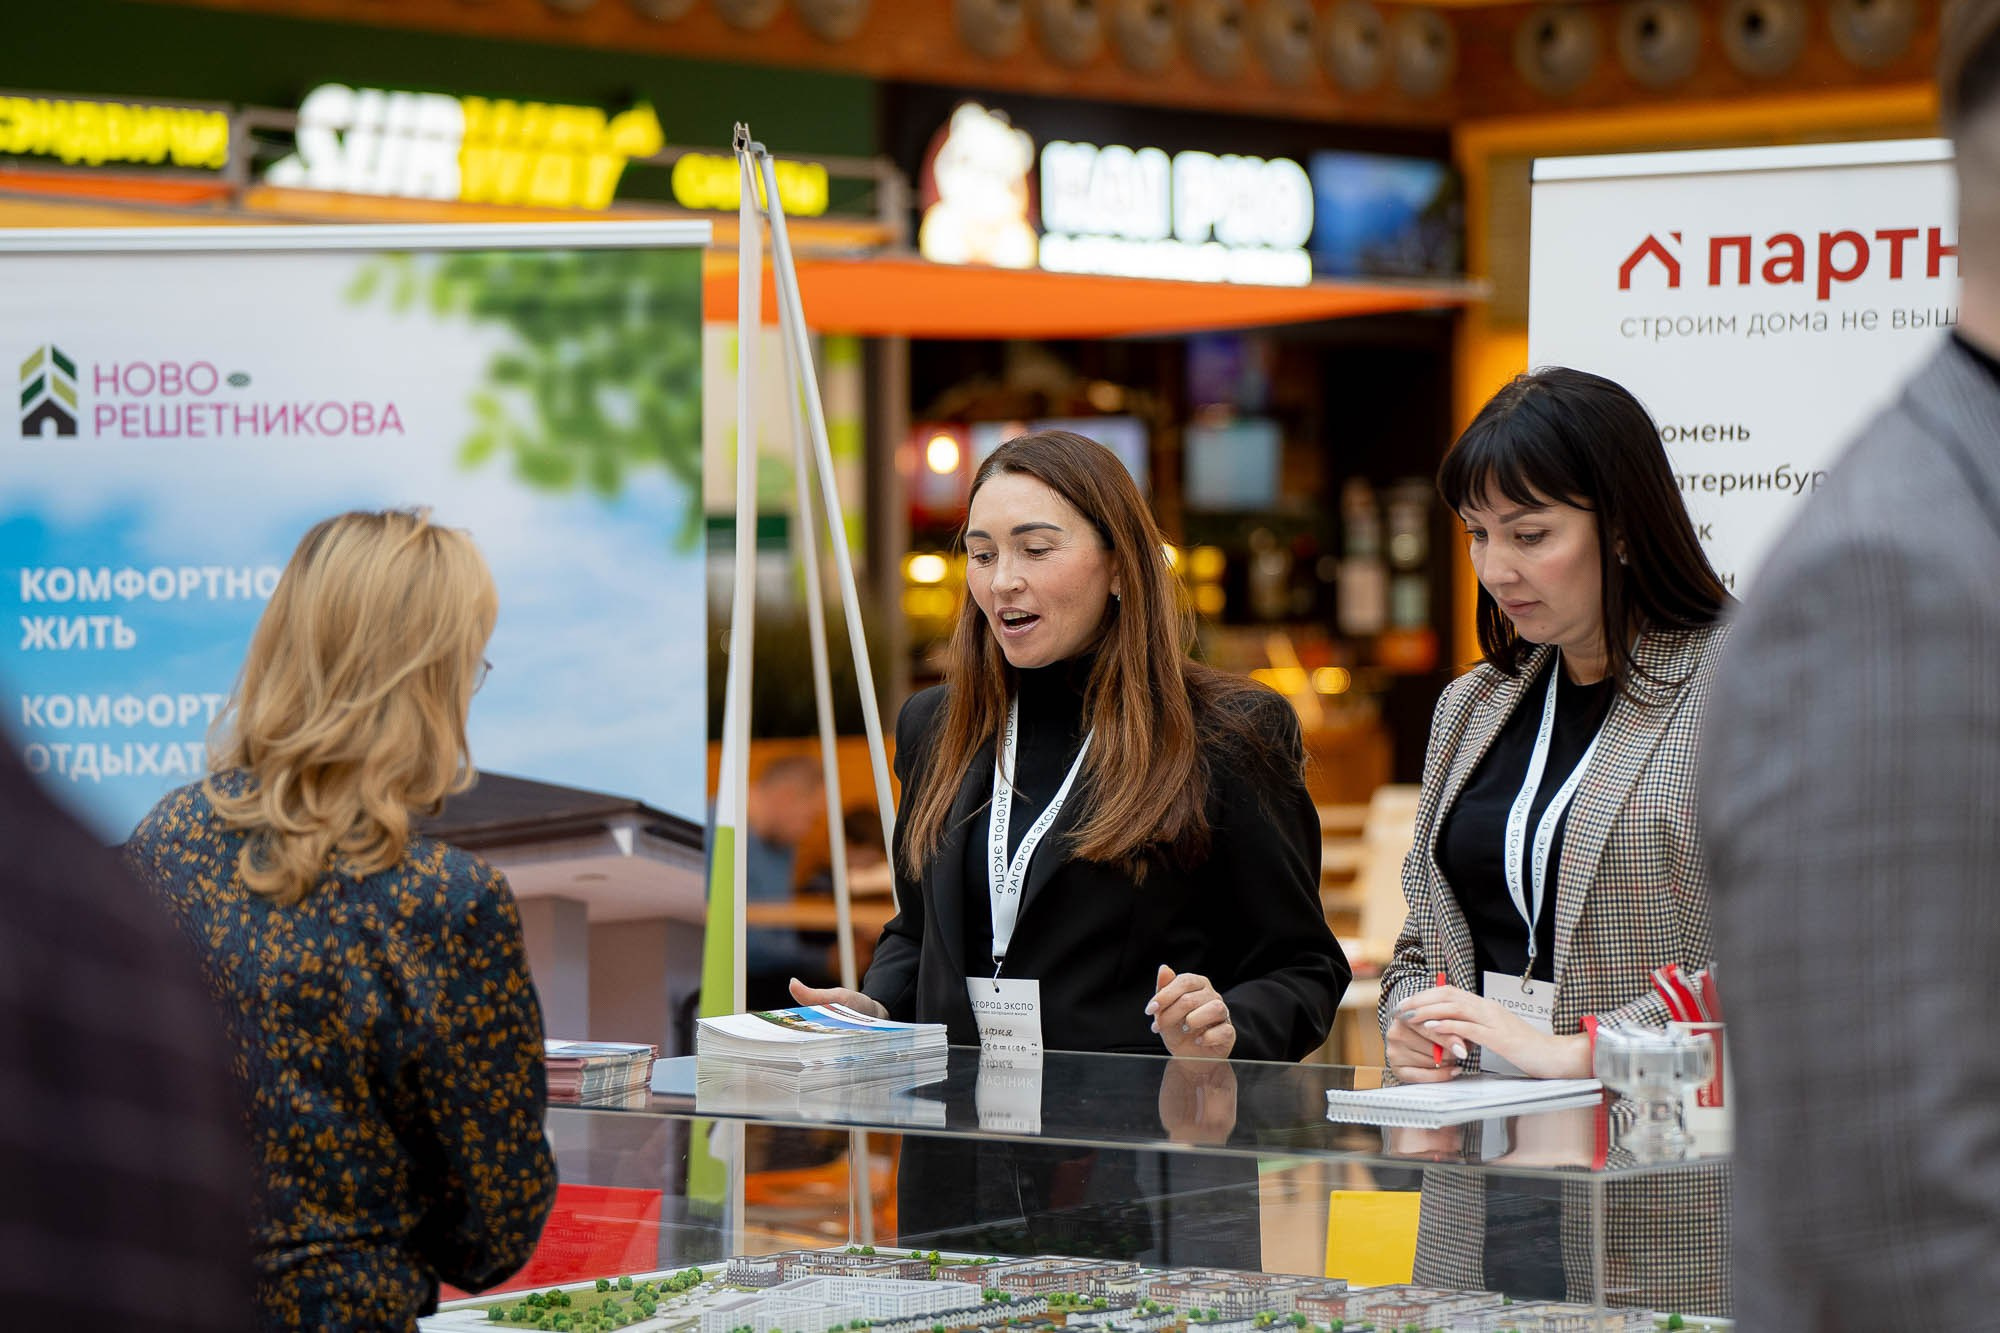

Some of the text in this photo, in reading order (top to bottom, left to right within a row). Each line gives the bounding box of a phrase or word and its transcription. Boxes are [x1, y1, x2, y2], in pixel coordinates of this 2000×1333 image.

[1708, 227, 1960, 301] партн
[1620, 305, 1958, 342] строим дома не выш
[94, 361, 219, 397] НОВО
[94, 402, 406, 438] РЕШЕТНИКОВА
[20, 566, 282, 602] КОМФОРТНО
[20, 615, 136, 650] ЖИТЬ
[21, 694, 222, 728] КОМФОРТ
[24, 742, 206, 782] ОТДЫХАТ
[993, 789, 1008, 894] ЗАГОРОД ЭКСПО
[1007, 800, 1064, 895] ЗАГОРОД ЭКСПО
[1509, 829, 1520, 894] ЗАГОРОД
[1535, 835, 1547, 888] ЭКСПО
[971, 1001, 1034, 1011] АГОРОД ЭКСПО
[1492, 997, 1534, 1013] ГОРОД
[1537, 1006, 1552, 1016] ЭК
[979, 1074, 1034, 1088] ЧАСТНИК
